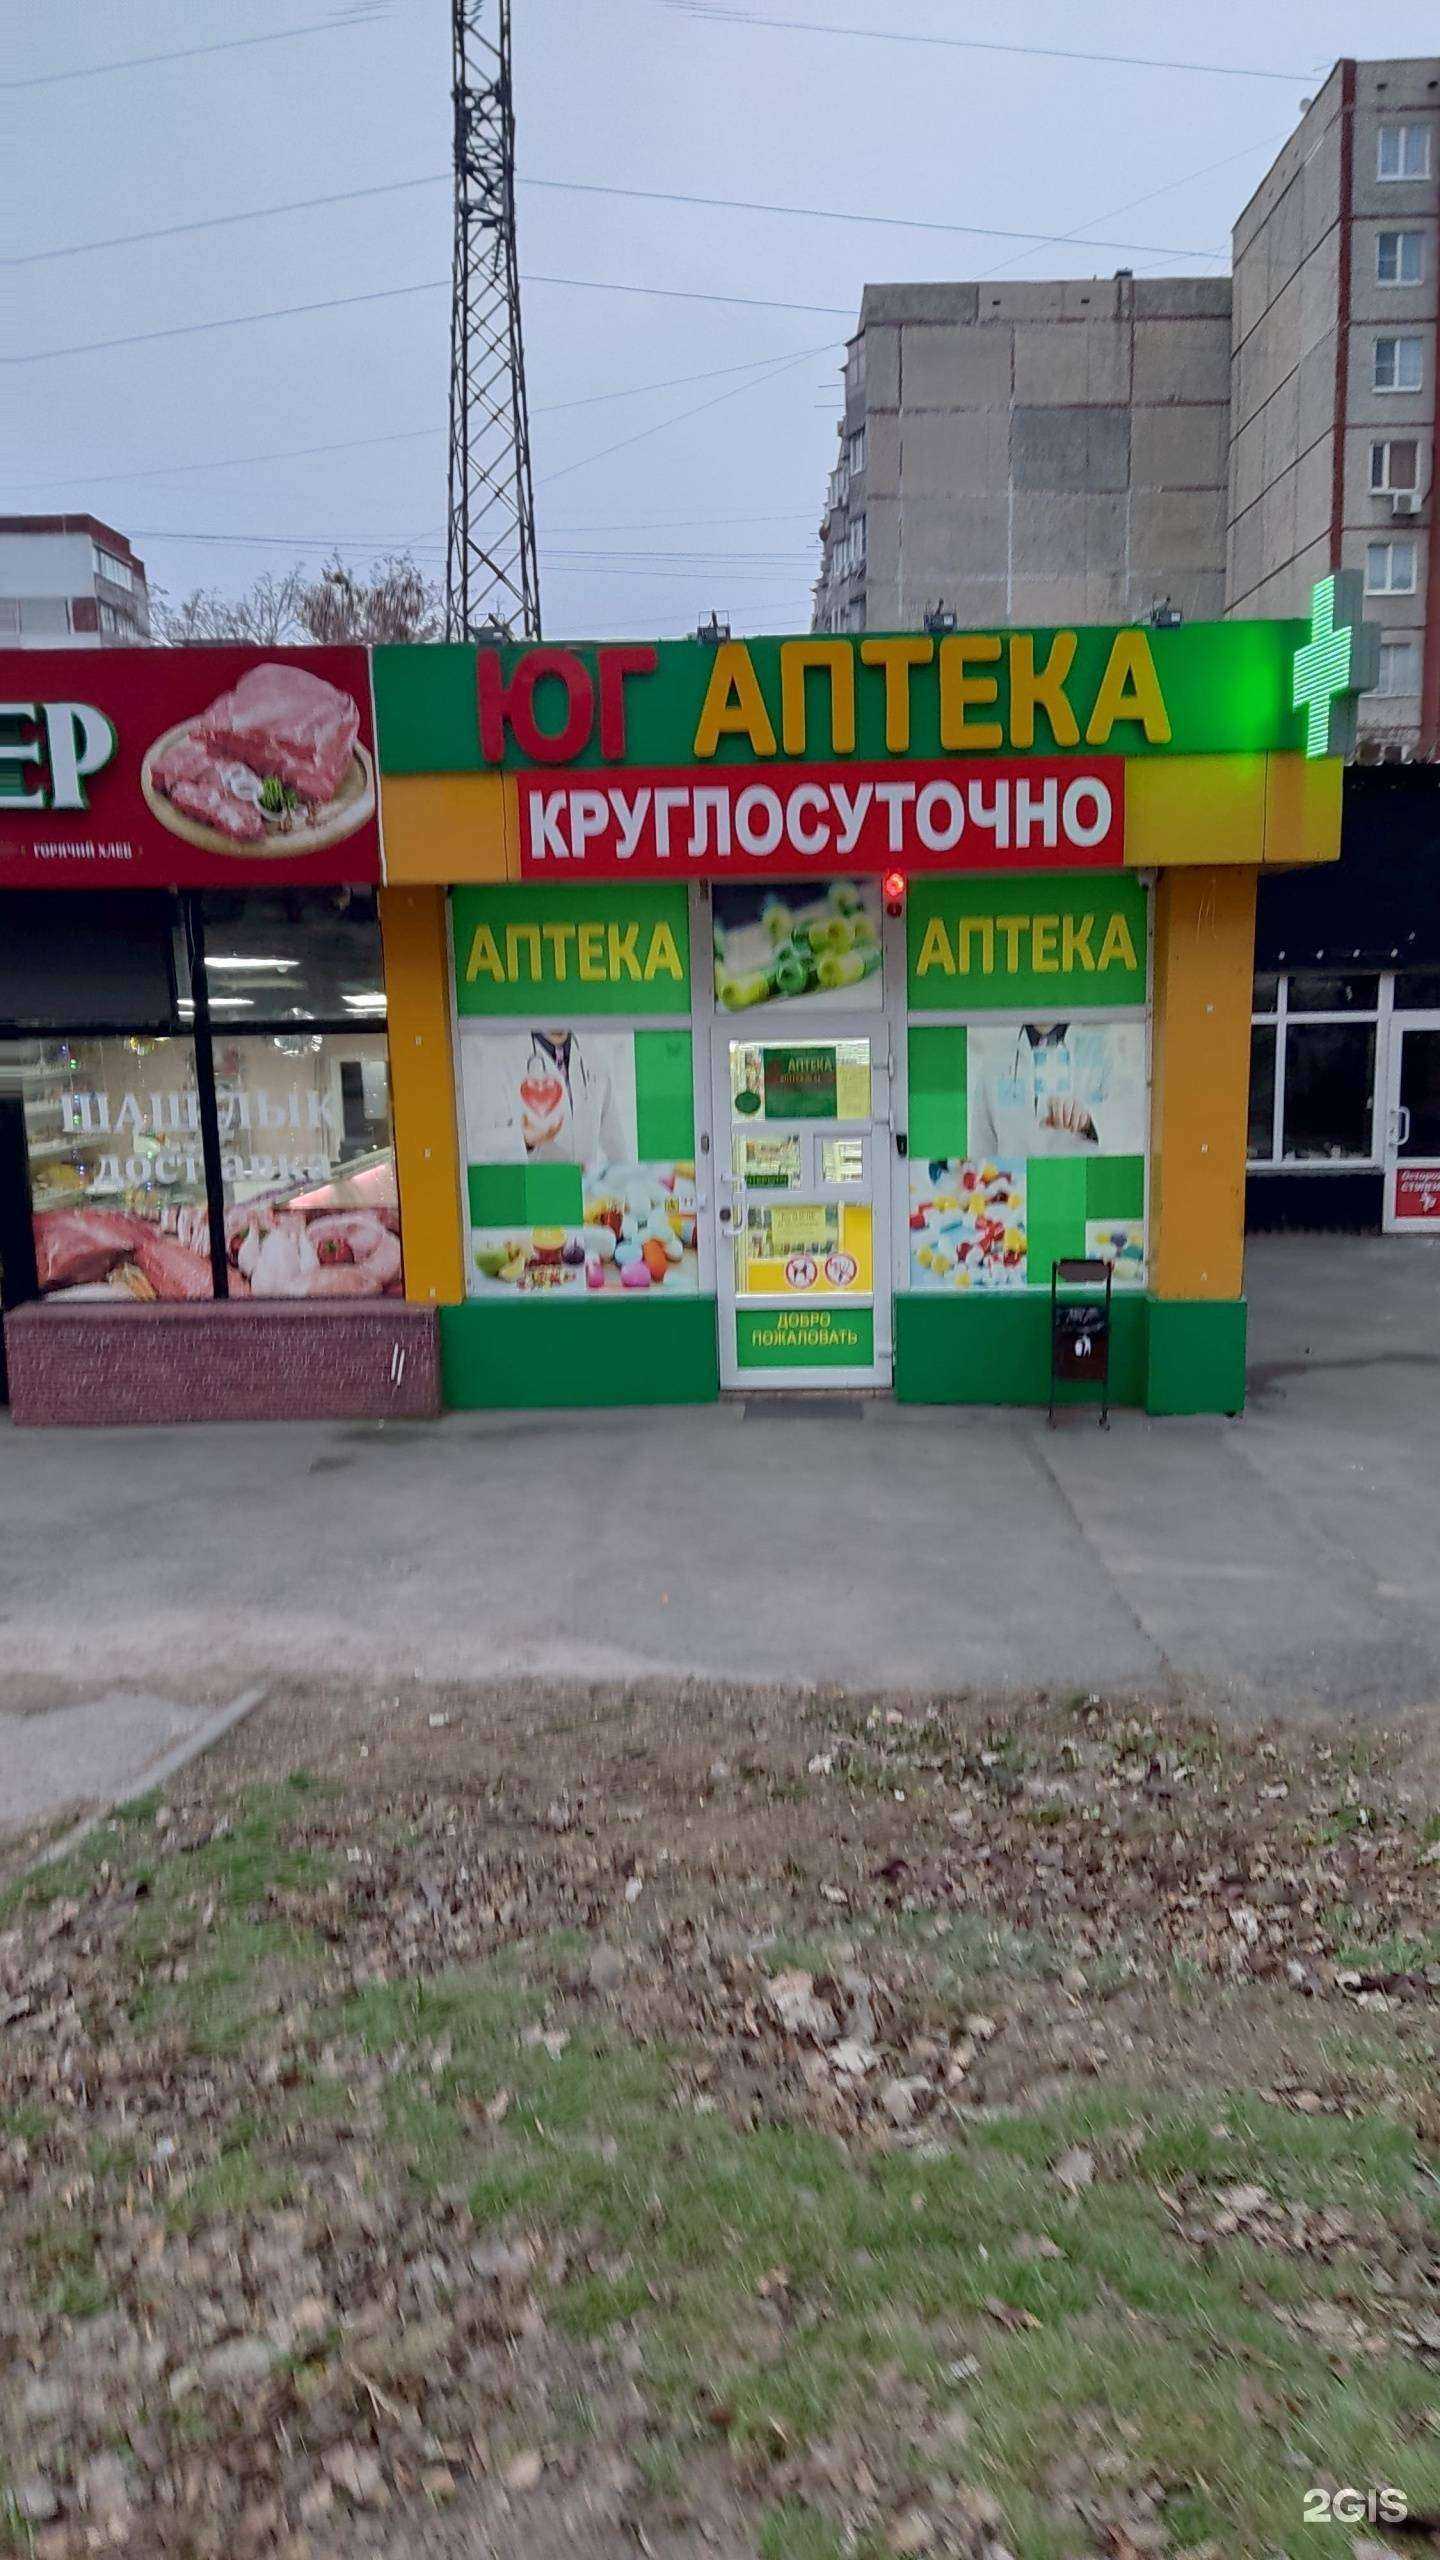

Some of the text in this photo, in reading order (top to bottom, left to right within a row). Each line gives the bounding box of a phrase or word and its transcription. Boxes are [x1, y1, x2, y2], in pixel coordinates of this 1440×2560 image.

[476, 629, 1172, 764] ЮГ АПТЕКА
[529, 775, 1113, 860] КРУГЛОСУТОЧНО
[466, 921, 684, 983] АПТЕКА
[916, 913, 1137, 977] АПТЕКА
[788, 1056, 833, 1073] АПТЕКА
[751, 1329, 858, 1346] ПОЖАЛОВАТЬ
[777, 1312, 831, 1329] ДОБРО
